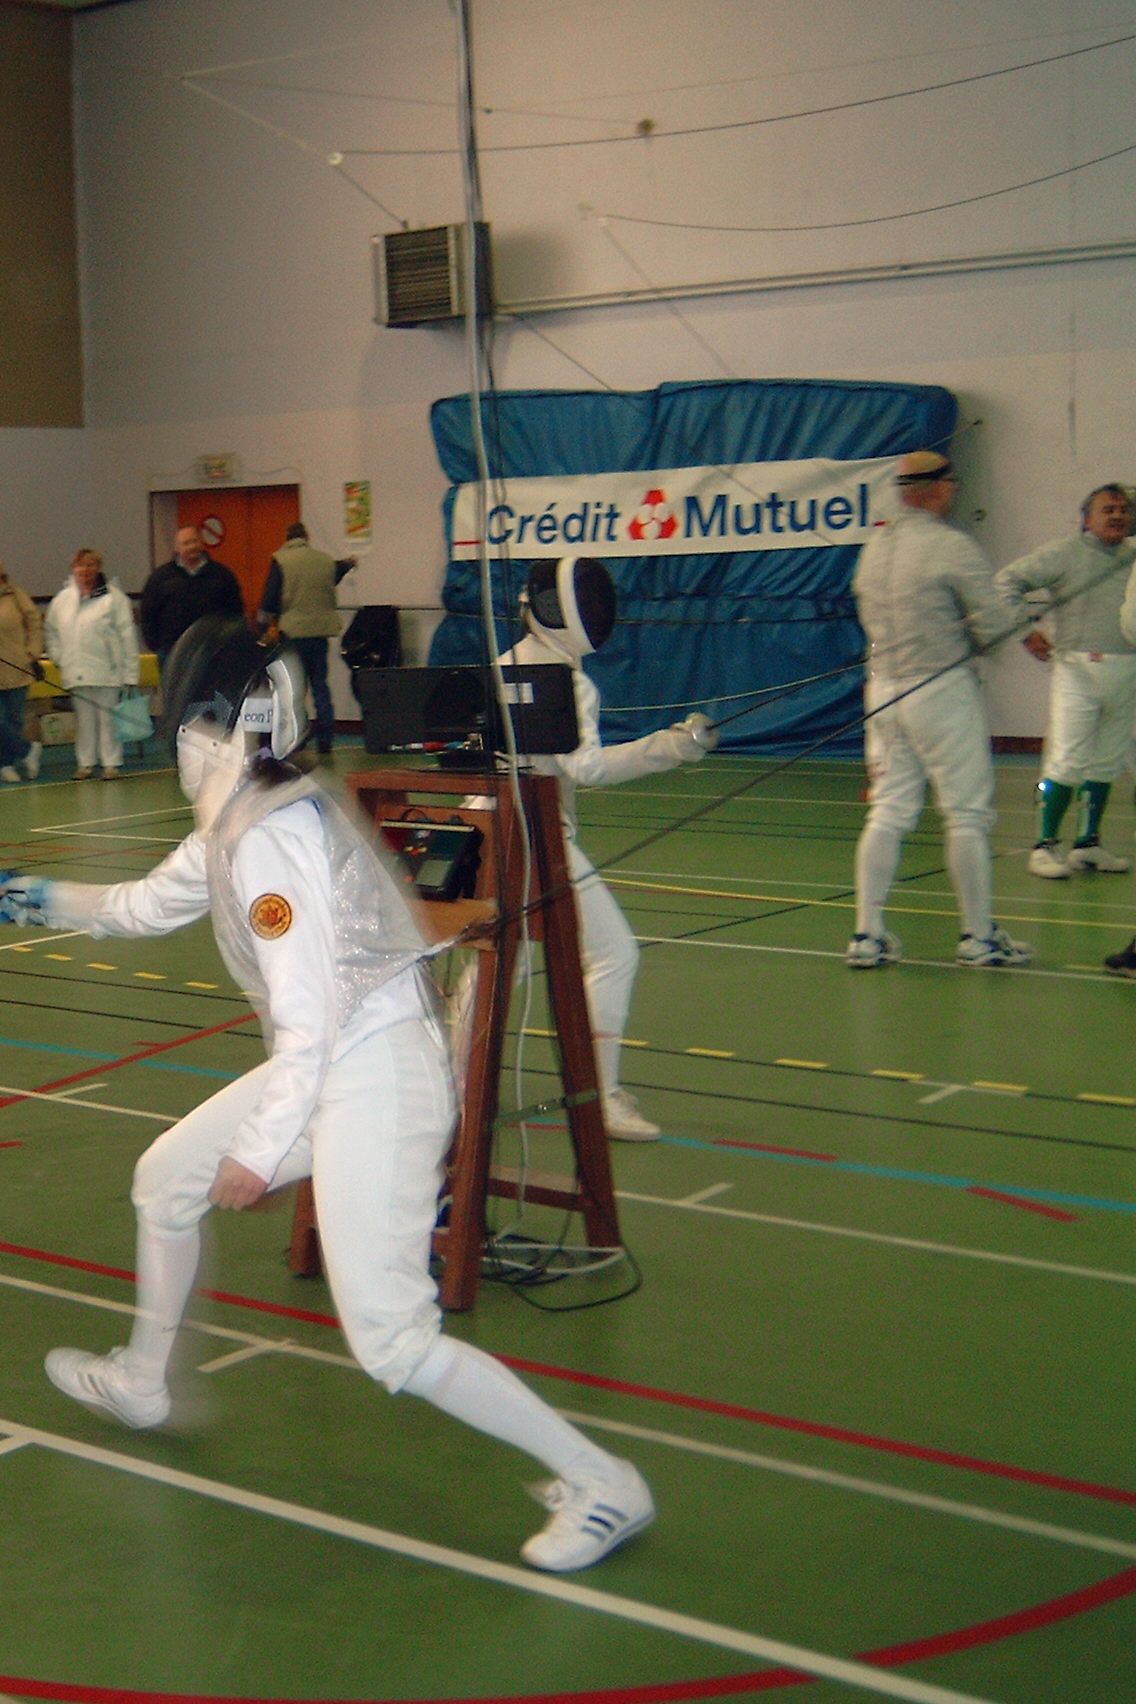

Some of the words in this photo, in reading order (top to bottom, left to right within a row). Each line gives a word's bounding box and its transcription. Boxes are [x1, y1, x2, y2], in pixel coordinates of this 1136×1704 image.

[487, 502, 622, 546] Crédit
[684, 483, 869, 538] Mutuel
[244, 712, 265, 723] eon
